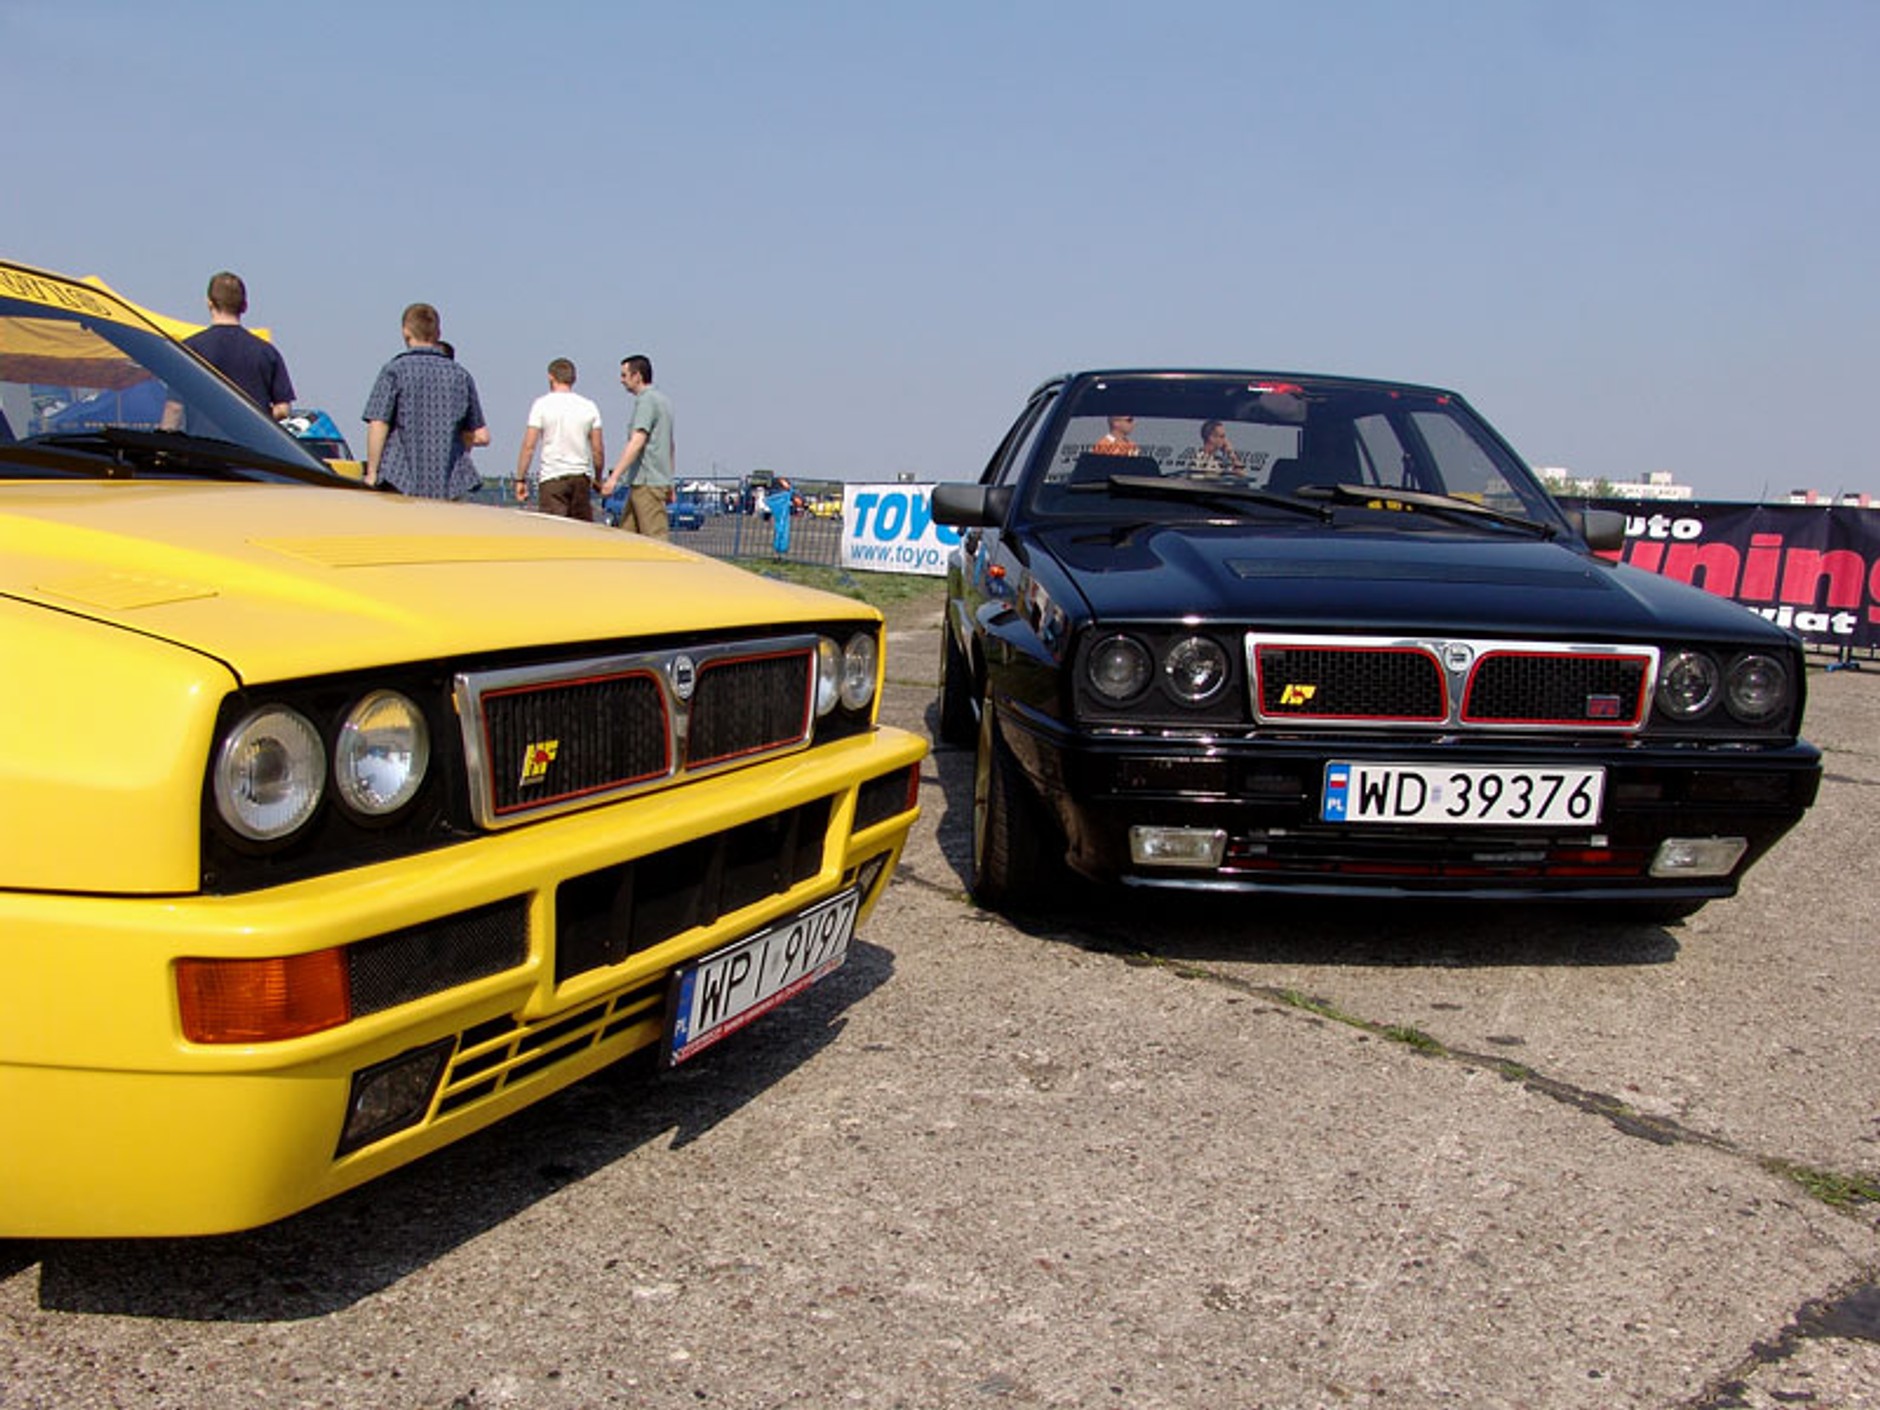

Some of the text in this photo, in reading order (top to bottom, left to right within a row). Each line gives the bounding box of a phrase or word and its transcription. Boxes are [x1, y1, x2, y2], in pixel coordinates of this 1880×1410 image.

[1625, 514, 1703, 540] uto
[1326, 797, 1345, 812] PL
[1358, 770, 1594, 820] WD 39376
[698, 898, 855, 1030] WPI 9V97
